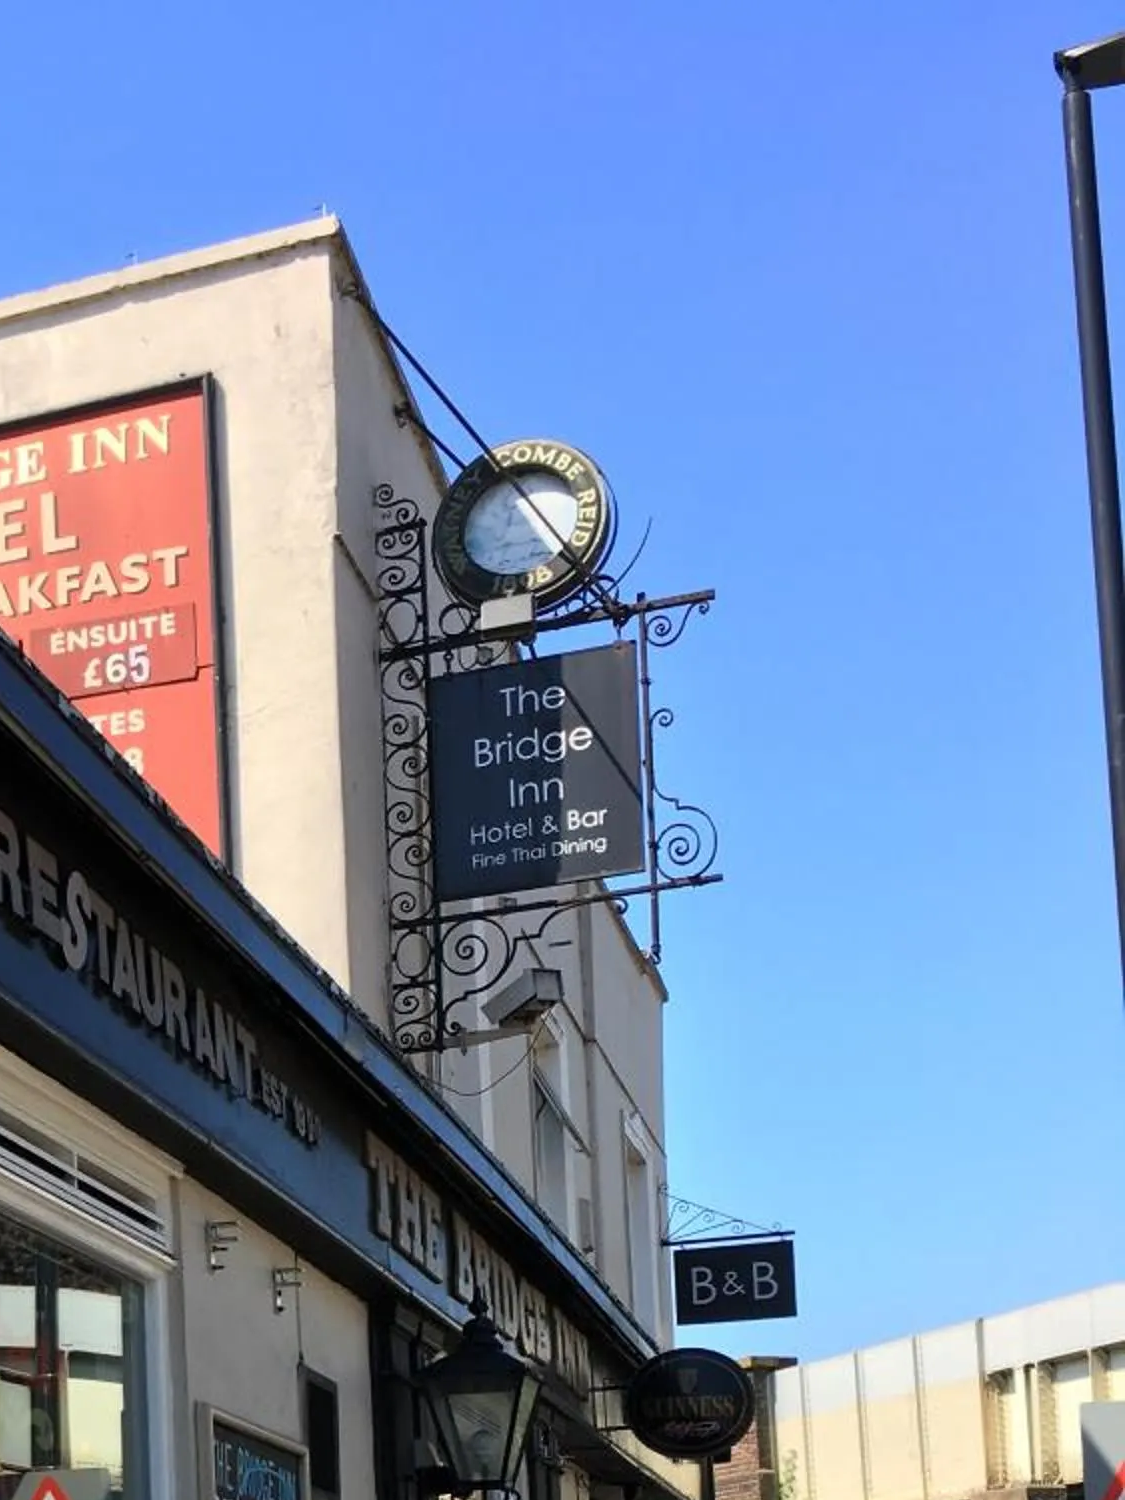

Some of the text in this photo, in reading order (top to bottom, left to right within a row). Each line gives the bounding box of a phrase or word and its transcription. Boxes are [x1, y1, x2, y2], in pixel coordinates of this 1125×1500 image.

[67, 415, 172, 474] INN
[496, 445, 585, 480] COMBE
[571, 487, 597, 547] REID
[49, 612, 176, 655] ENSUITE
[84, 644, 151, 689] £65
[89, 708, 145, 736] TES
[499, 685, 566, 717] The
[475, 726, 594, 768] Bridge
[509, 777, 565, 808] Inn
[469, 808, 608, 846] Hotel & Bar
[472, 837, 608, 870] Fine Thai Dining
[365, 1129, 444, 1284] THE
[452, 1209, 553, 1366] BRIDGE
